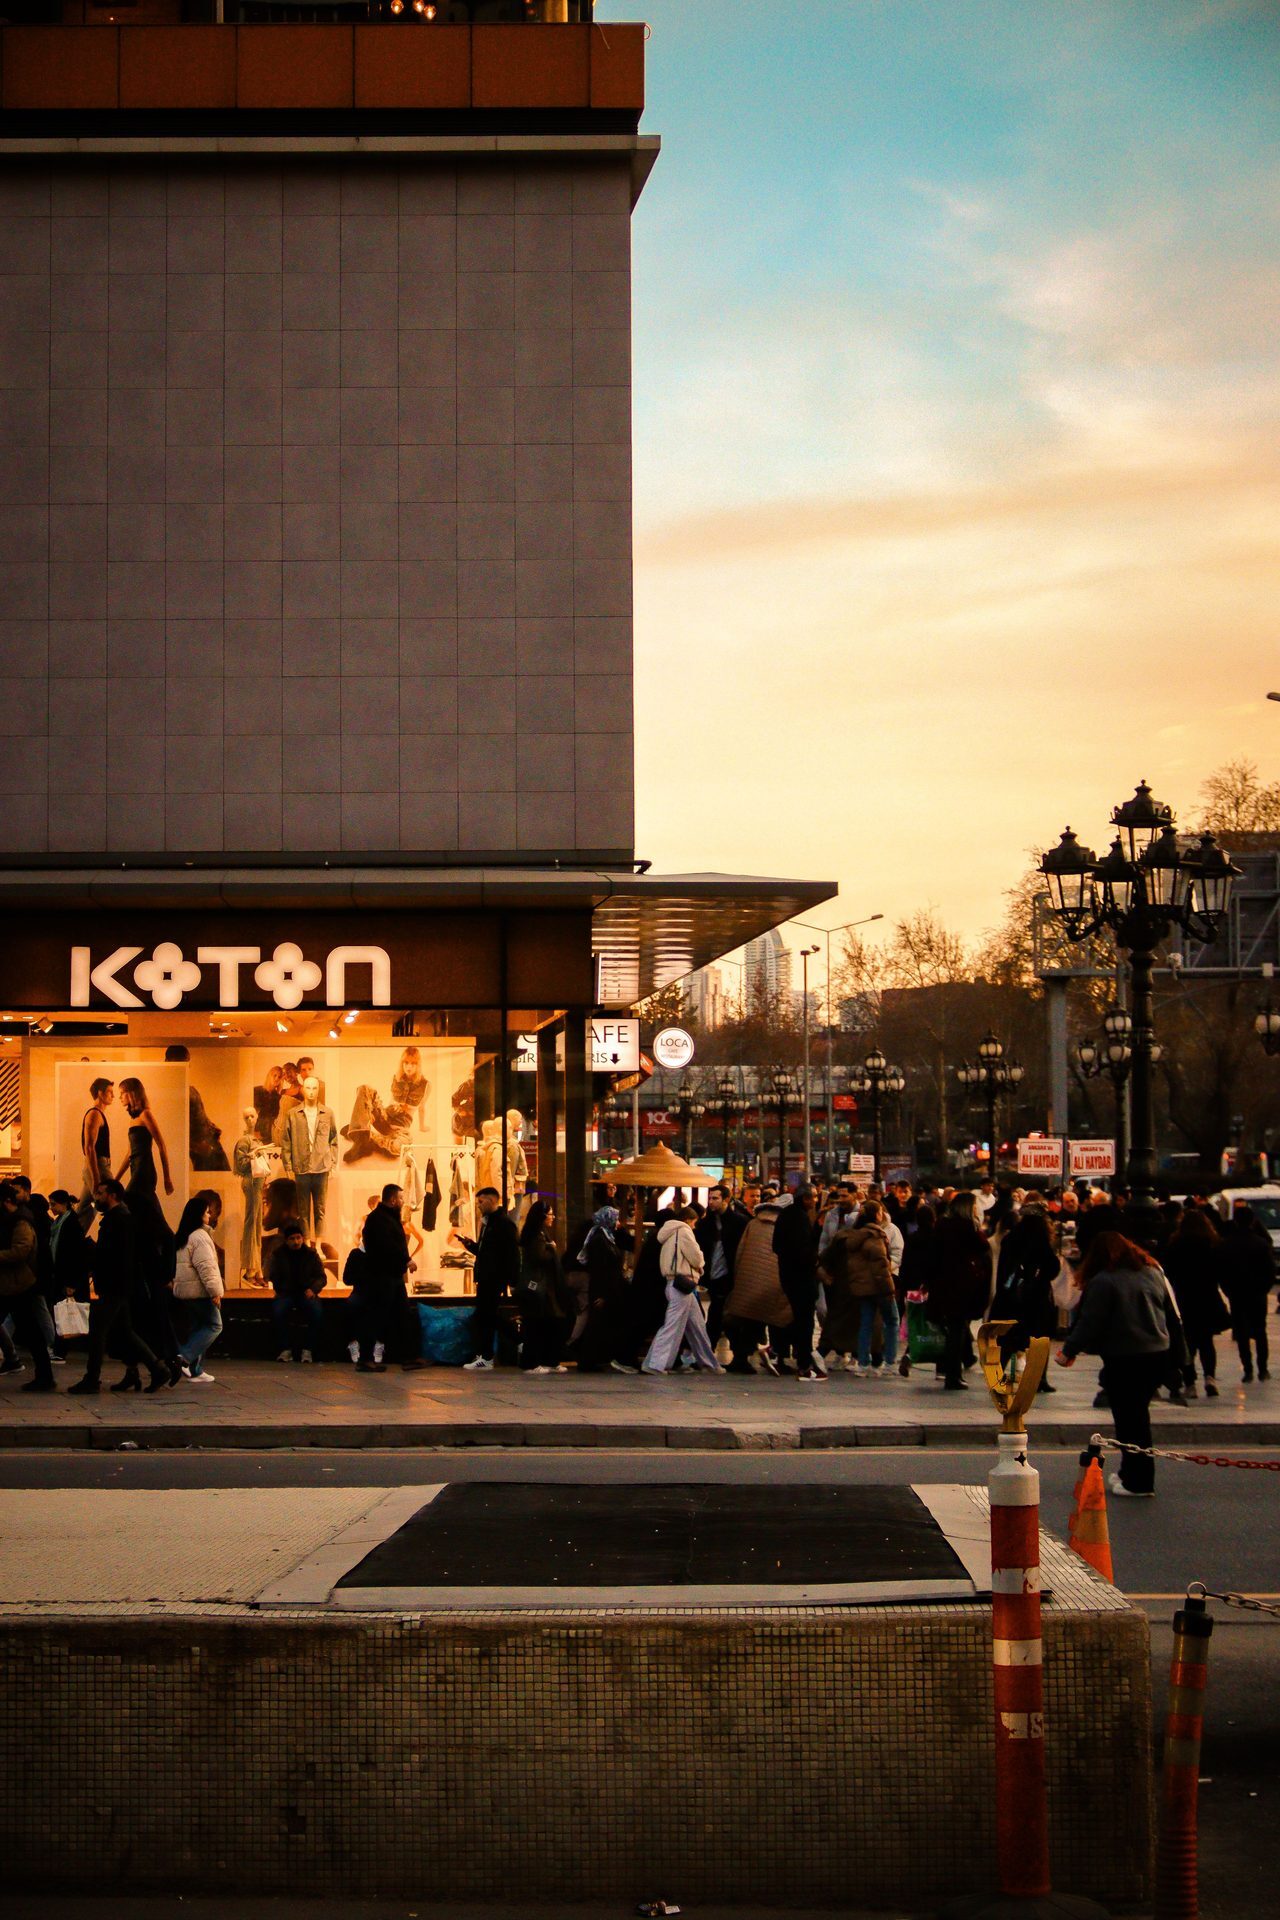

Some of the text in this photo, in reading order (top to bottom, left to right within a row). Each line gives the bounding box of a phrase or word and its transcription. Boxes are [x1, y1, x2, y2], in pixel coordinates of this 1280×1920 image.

[70, 941, 391, 1010] KOTON
[585, 1025, 629, 1043] AFE
[660, 1038, 689, 1048] LOCA
